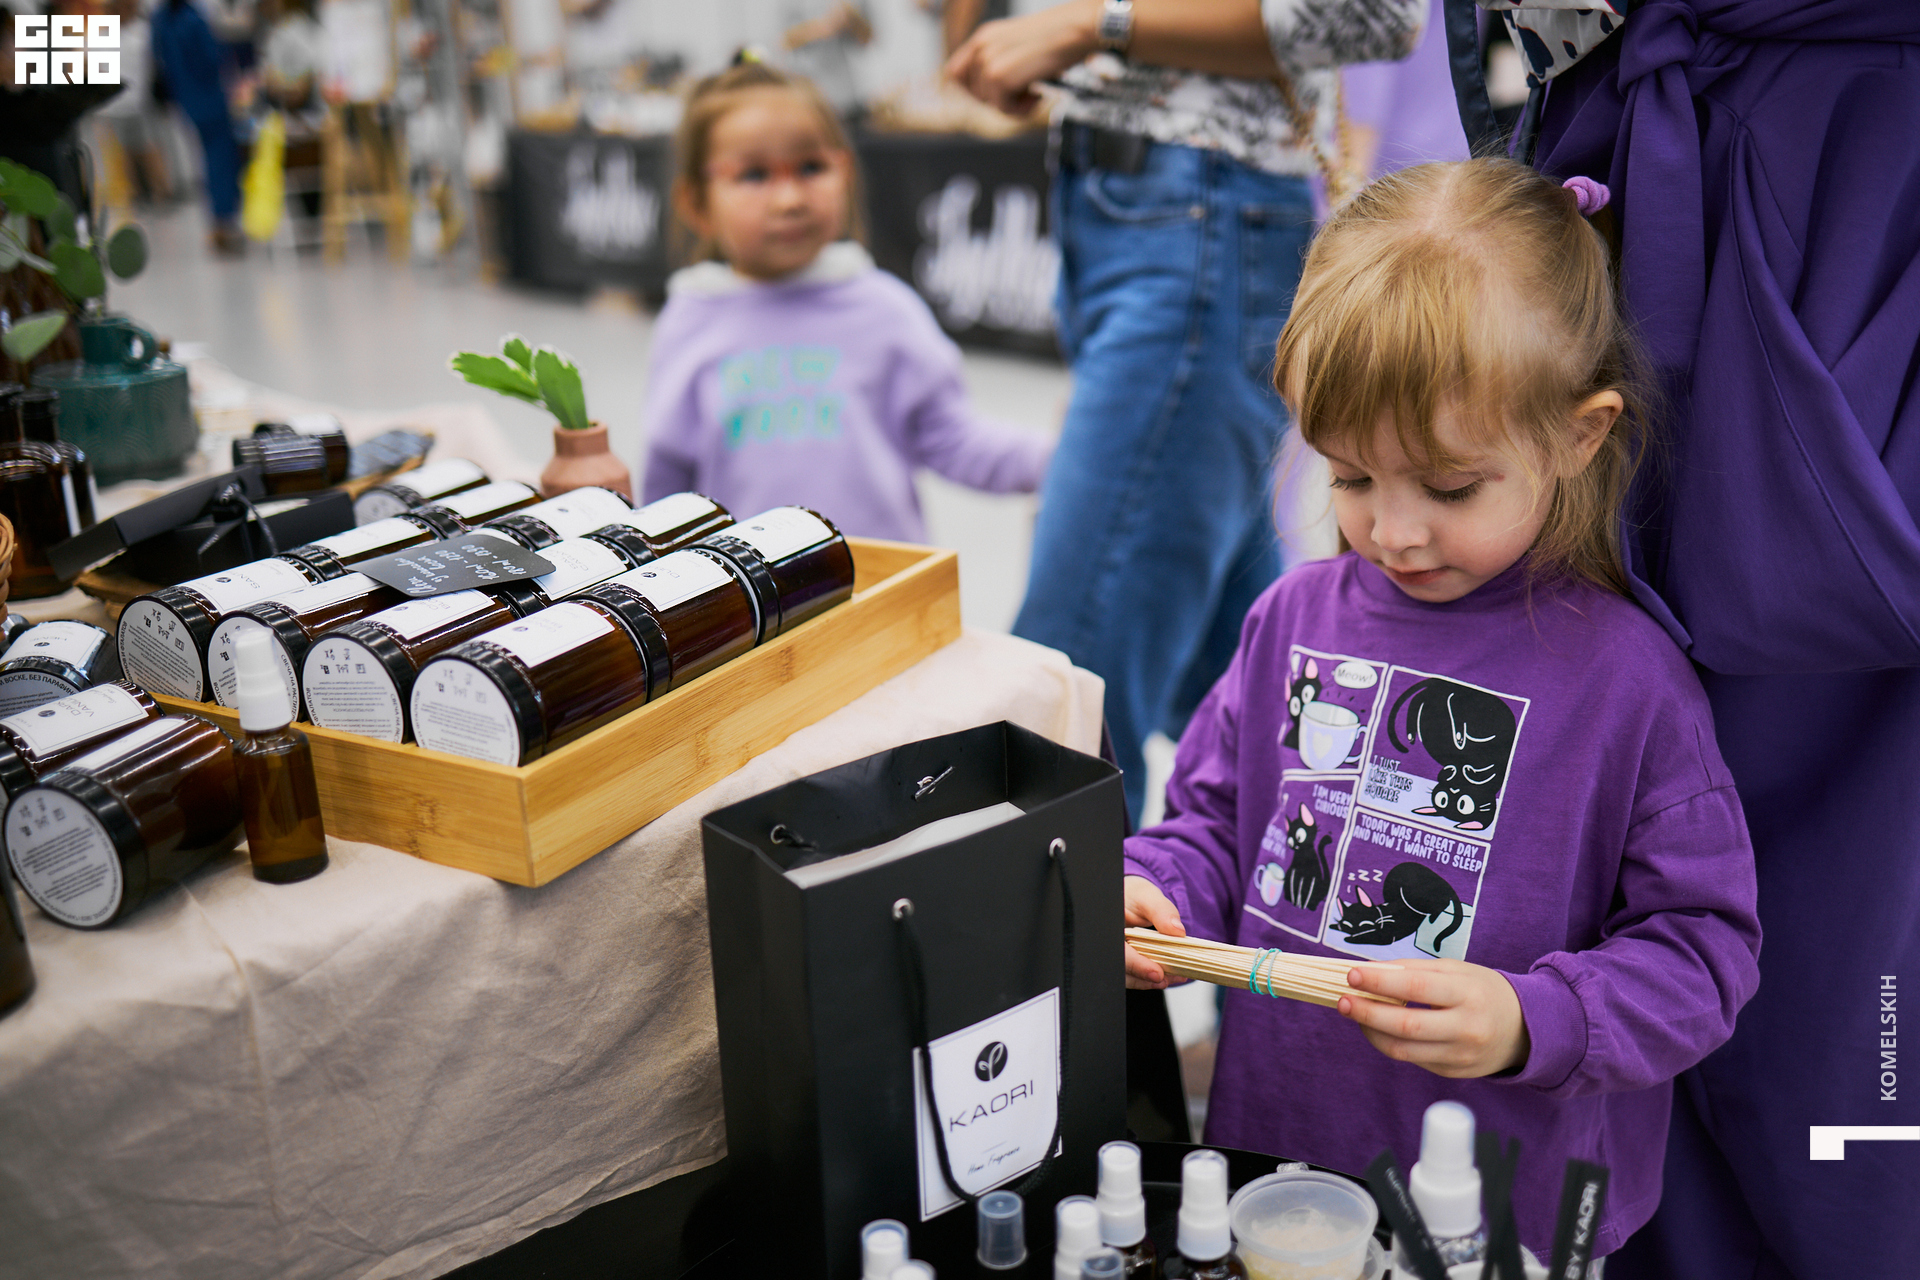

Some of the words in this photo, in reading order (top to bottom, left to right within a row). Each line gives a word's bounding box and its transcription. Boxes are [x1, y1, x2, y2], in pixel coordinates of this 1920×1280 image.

[281, 654, 292, 676] СВЕЧА
[1337, 668, 1373, 684] Meow!
[4, 673, 28, 684] ВОСКЕ,
[1368, 768, 1389, 784] LIKE
[1389, 773, 1414, 792] THIS
[1329, 789, 1353, 806] VERY
[1364, 782, 1400, 803] SQUARE
[1314, 798, 1349, 819] CURIOUS
[1361, 814, 1390, 834] TODAY
[1390, 823, 1413, 841] WAS
[1413, 831, 1422, 843] A
[1423, 833, 1456, 853] GREAT
[1456, 842, 1479, 859] DAY
[1353, 825, 1371, 842] AND
[1371, 830, 1395, 849] NOW
[1395, 838, 1402, 851] I
[1403, 841, 1434, 860] WANT
[1435, 849, 1451, 865] TO
[1452, 854, 1483, 873] SLEEP
[949, 1079, 1034, 1132] KAORI
[1574, 1182, 1600, 1246] KAORI
